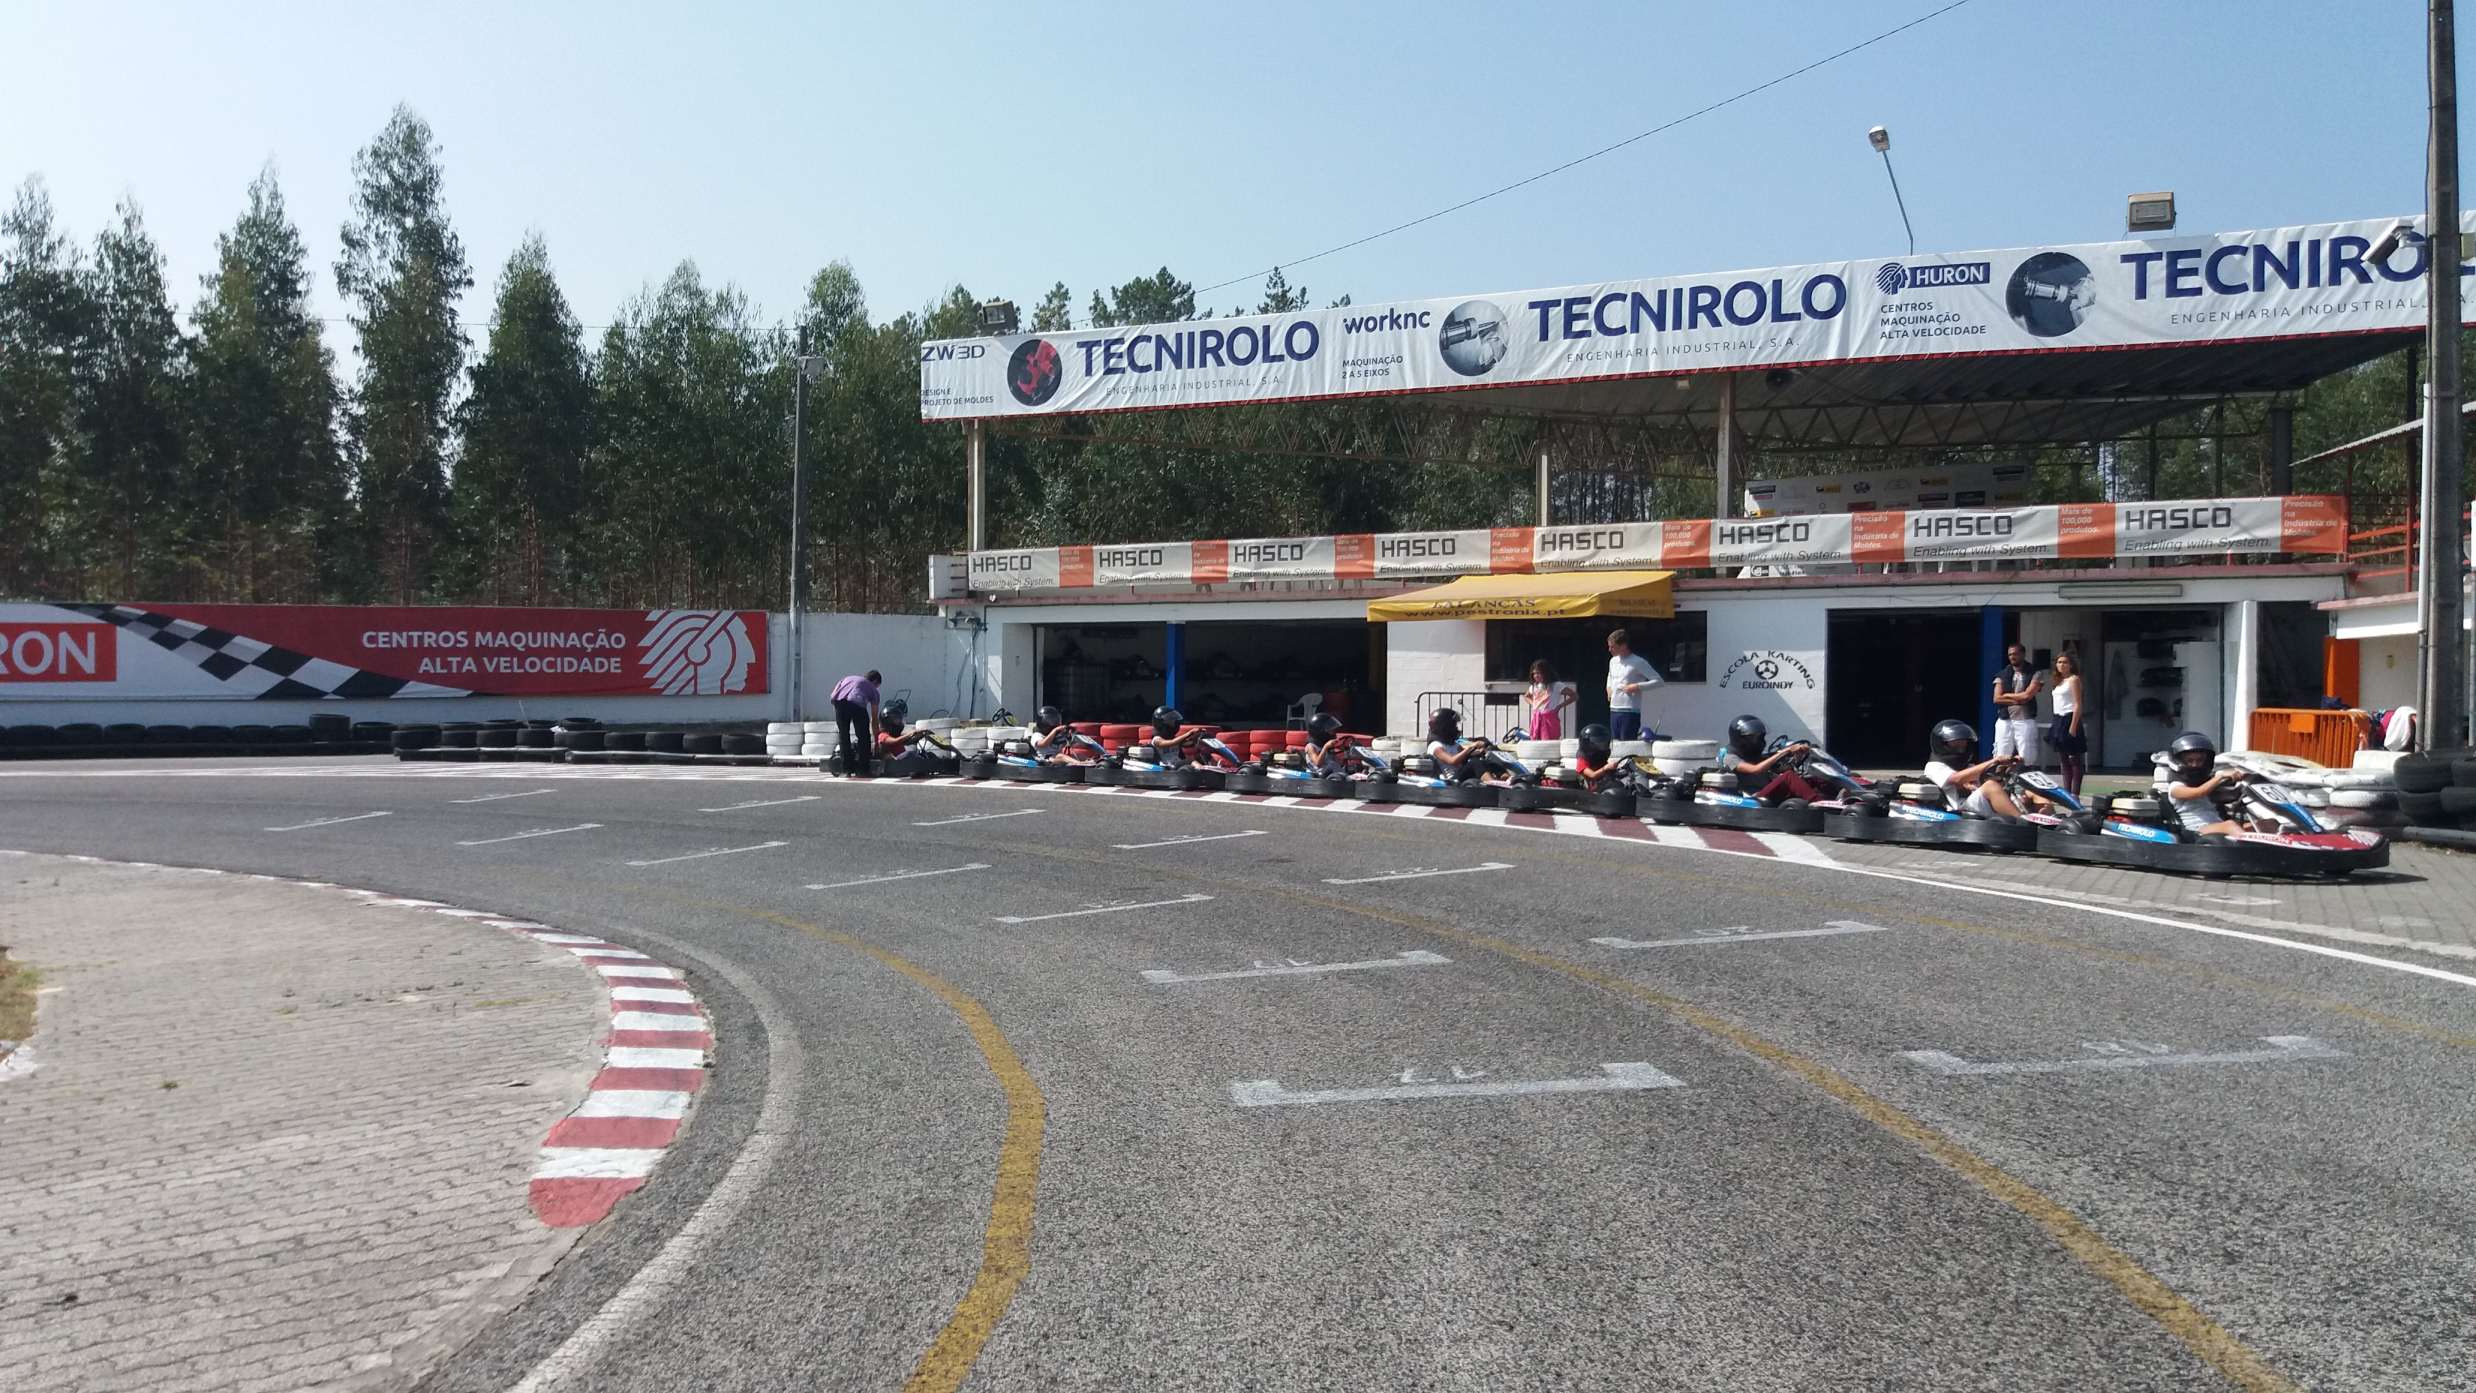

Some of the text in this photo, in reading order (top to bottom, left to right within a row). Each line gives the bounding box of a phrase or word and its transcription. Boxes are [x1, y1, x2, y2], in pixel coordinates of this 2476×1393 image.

[2120, 231, 2476, 301] TECNIRO
[1915, 266, 1984, 286] HURON
[1527, 273, 1847, 342] TECNIROLO
[1880, 302, 1933, 314] CENTROS
[2171, 307, 2291, 324] ENGENHARIA
[1343, 307, 1431, 335] worknc
[1880, 312, 1961, 327] MAQUINAÇÃO
[1880, 325, 1987, 340] ALTA VELOCIDADE
[1076, 320, 1320, 377] TECNIROLO
[1567, 347, 1658, 363] ENGENHARIA
[1342, 354, 1404, 368] MAQUINAÇÃO
[1342, 368, 1390, 379] 2 A 5 EIXOS
[1106, 382, 1178, 396] ENGENHARIA
[964, 396, 994, 404] MOLDES
[1914, 515, 2013, 538] HASCO
[2125, 506, 2232, 531] HASCO
[1541, 531, 1624, 552] HASCO
[1719, 522, 1810, 545] HASCO
[1234, 544, 1303, 563] HASCO
[1381, 538, 1456, 558] HASCO
[1913, 545, 1967, 558] Enabling
[1970, 544, 1996, 555] with
[2124, 538, 2183, 552] Enabling
[2187, 537, 2213, 549] with
[973, 555, 1032, 573] HASCO
[1099, 549, 1163, 568] HASCO
[362, 628, 626, 652] CENTROS MAQUINAÇÃO
[418, 656, 622, 674] ALTA VELOCIDADE
[1719, 650, 1816, 690] ESCOLA KARTING
[1742, 681, 1794, 690] EUROINDY
